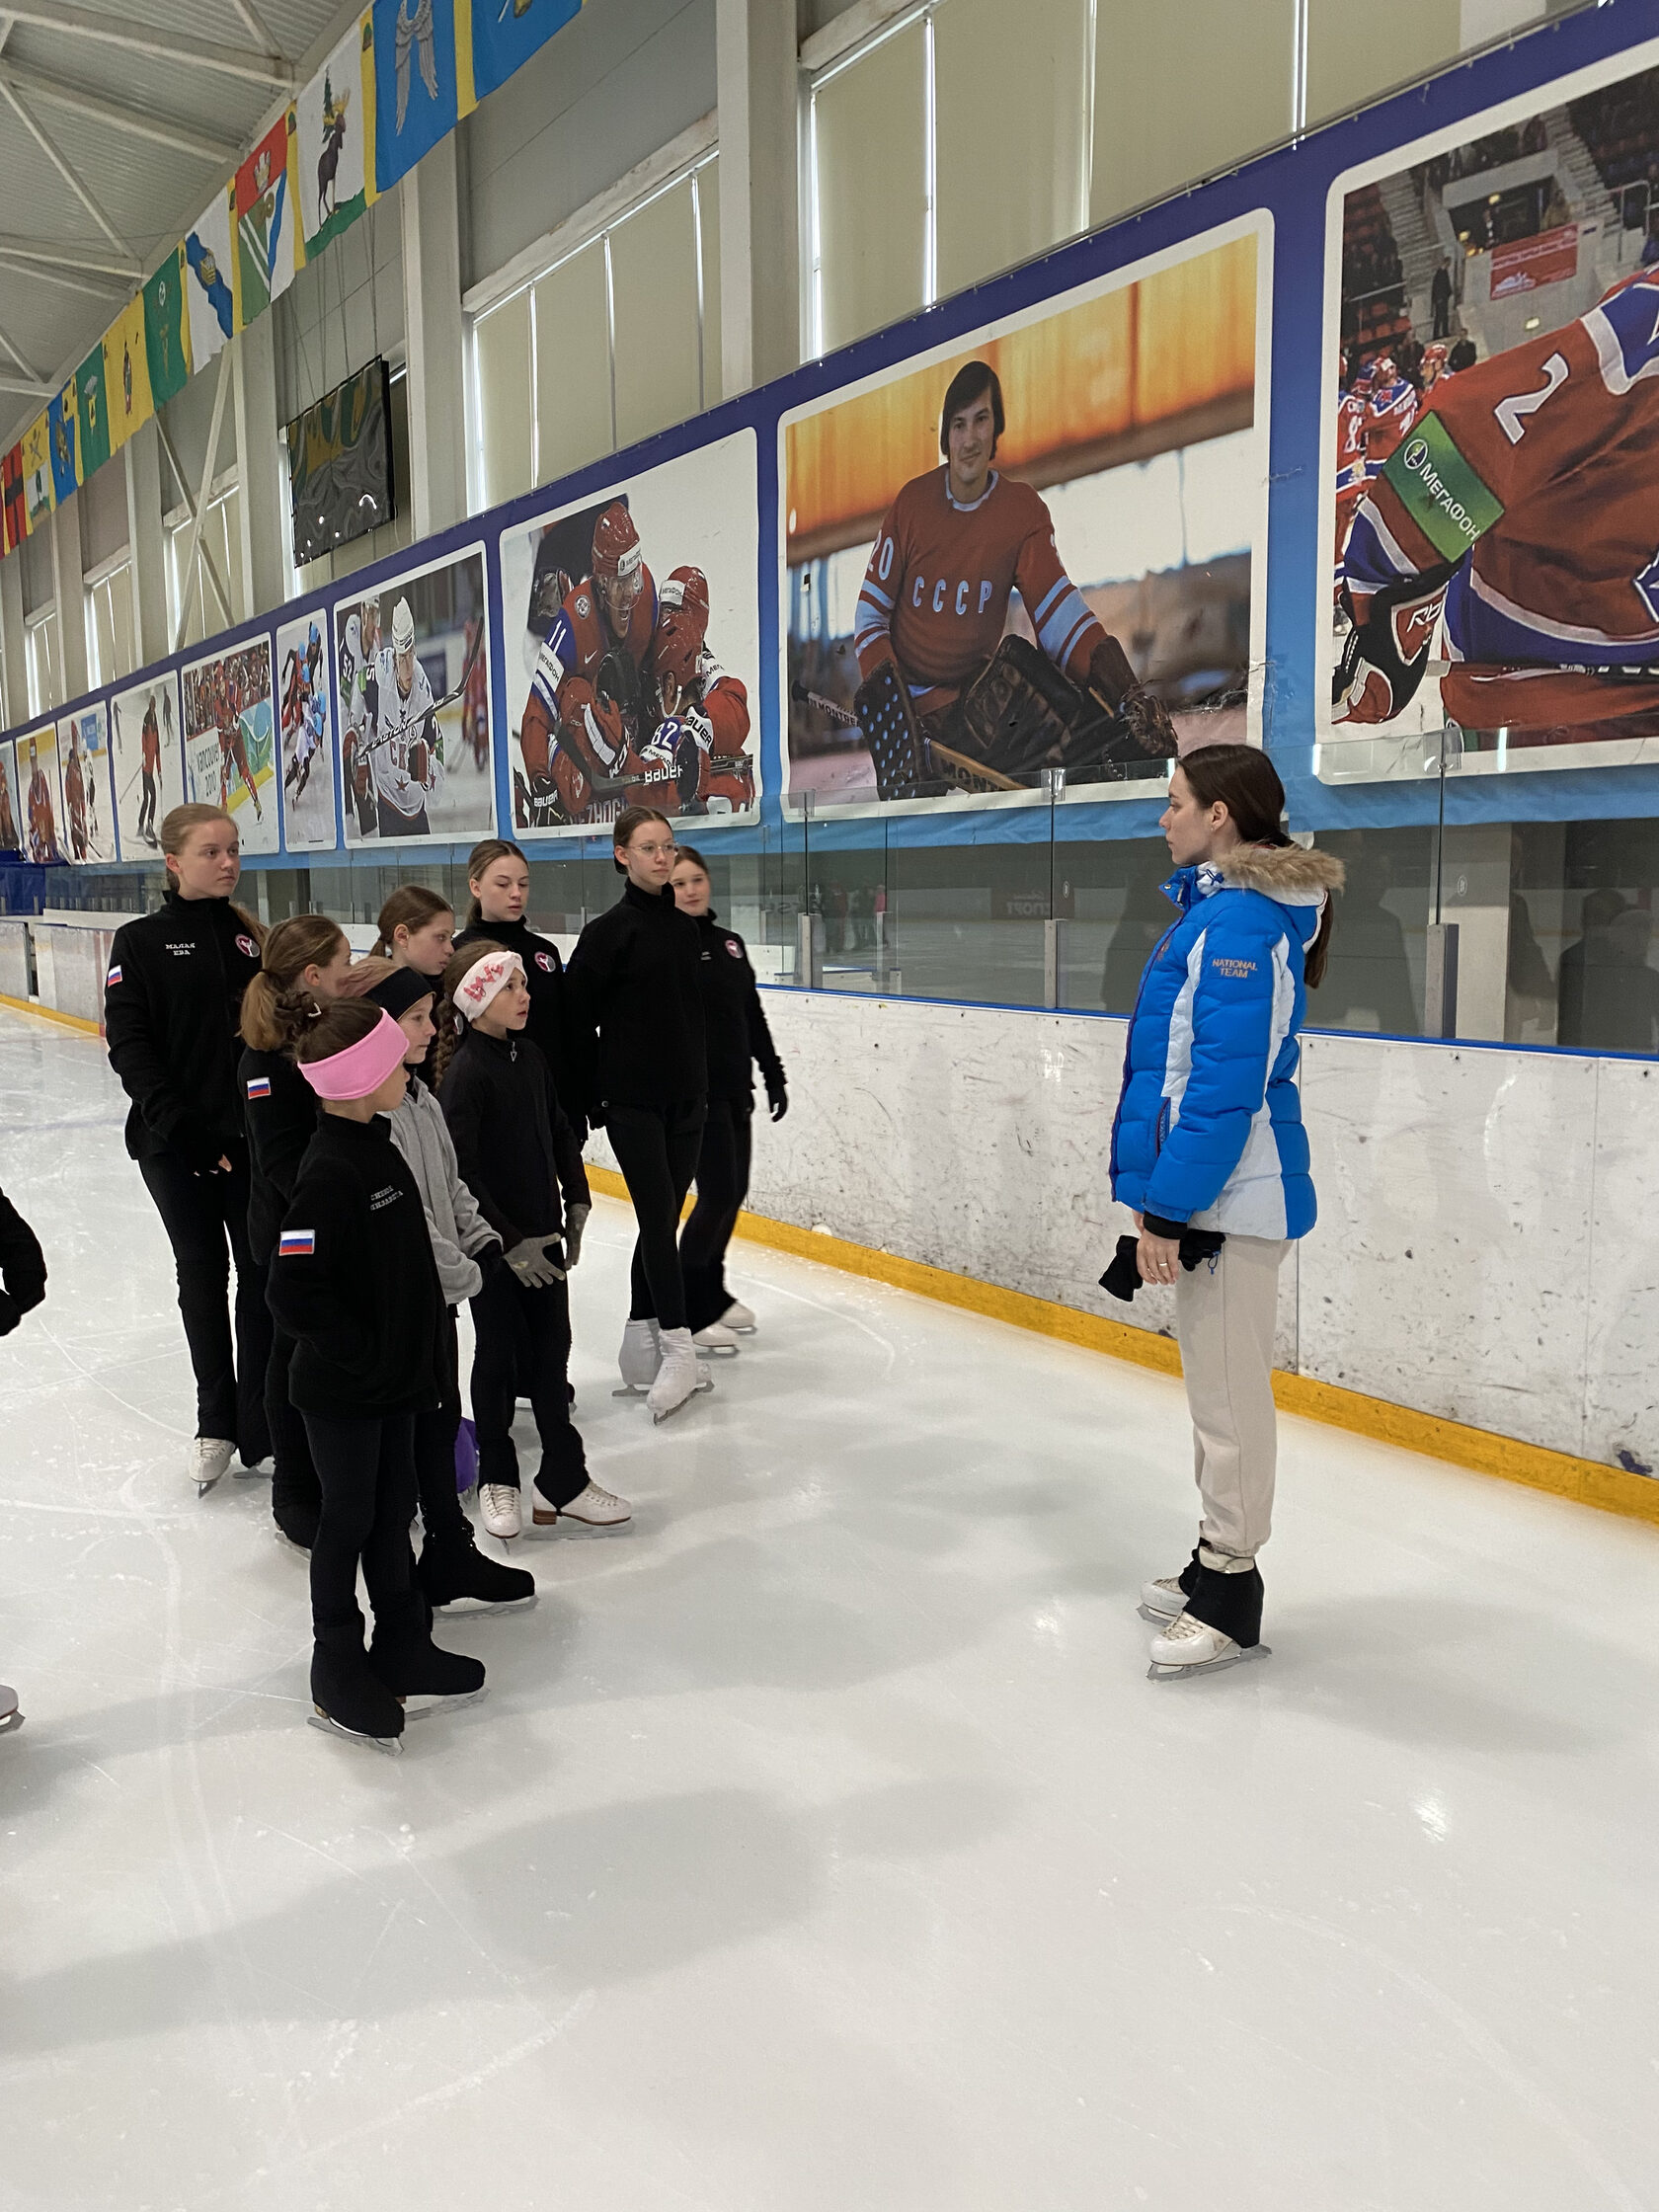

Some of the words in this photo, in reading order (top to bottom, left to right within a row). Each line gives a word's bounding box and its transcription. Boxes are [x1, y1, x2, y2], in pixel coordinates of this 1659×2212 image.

[1493, 352, 1569, 445] 2
[548, 619, 567, 656] 11
[1212, 958, 1257, 972] NATIONAL
[1221, 968, 1249, 979] TEAM
